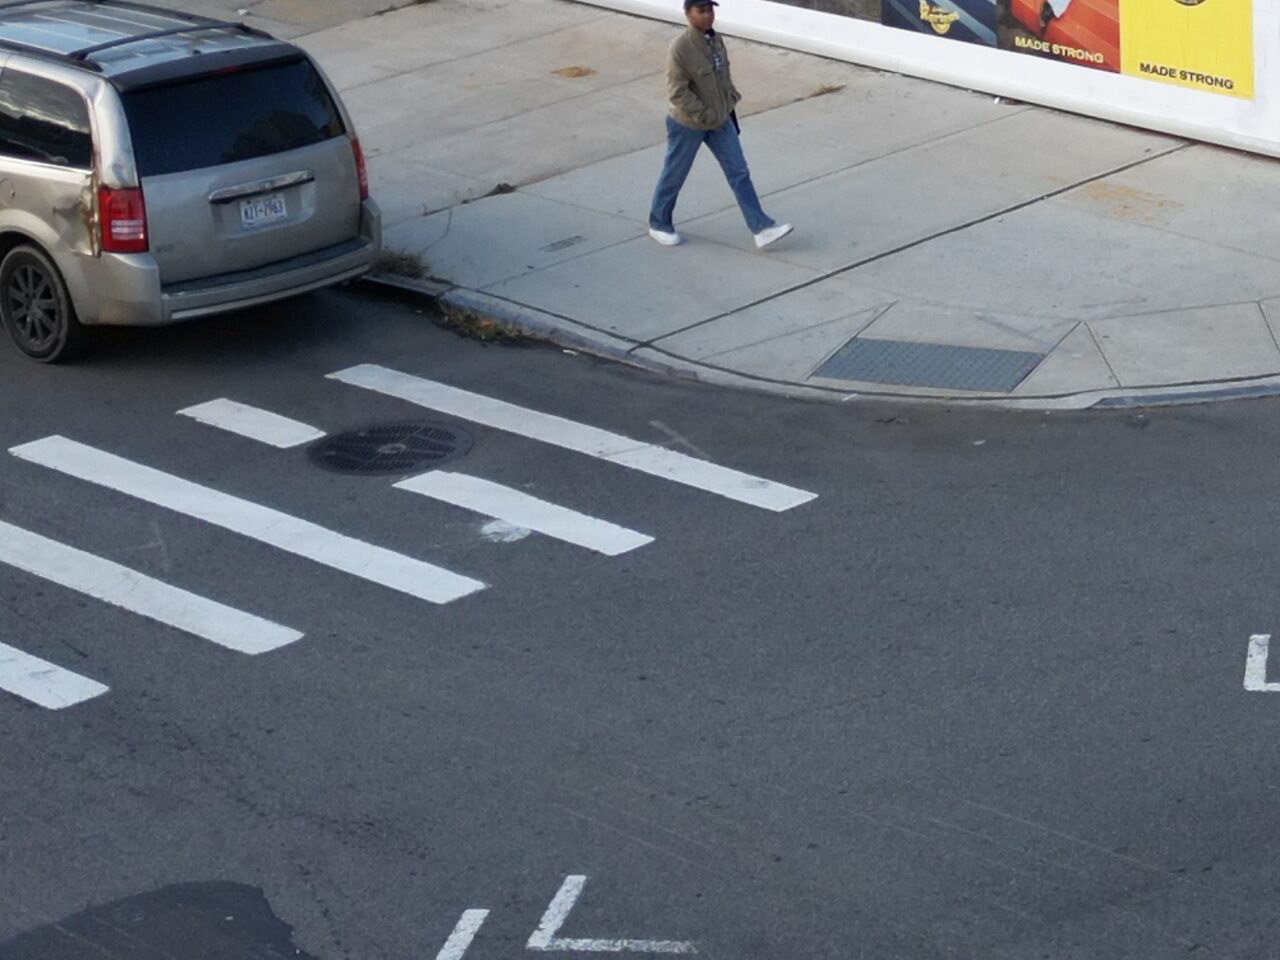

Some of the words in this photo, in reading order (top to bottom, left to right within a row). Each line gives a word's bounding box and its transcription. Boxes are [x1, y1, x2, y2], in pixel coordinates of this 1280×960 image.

[1014, 36, 1050, 53] MADE
[1051, 44, 1104, 64] STRONG
[1139, 62, 1177, 79] MADE
[1179, 71, 1234, 90] STRONG
